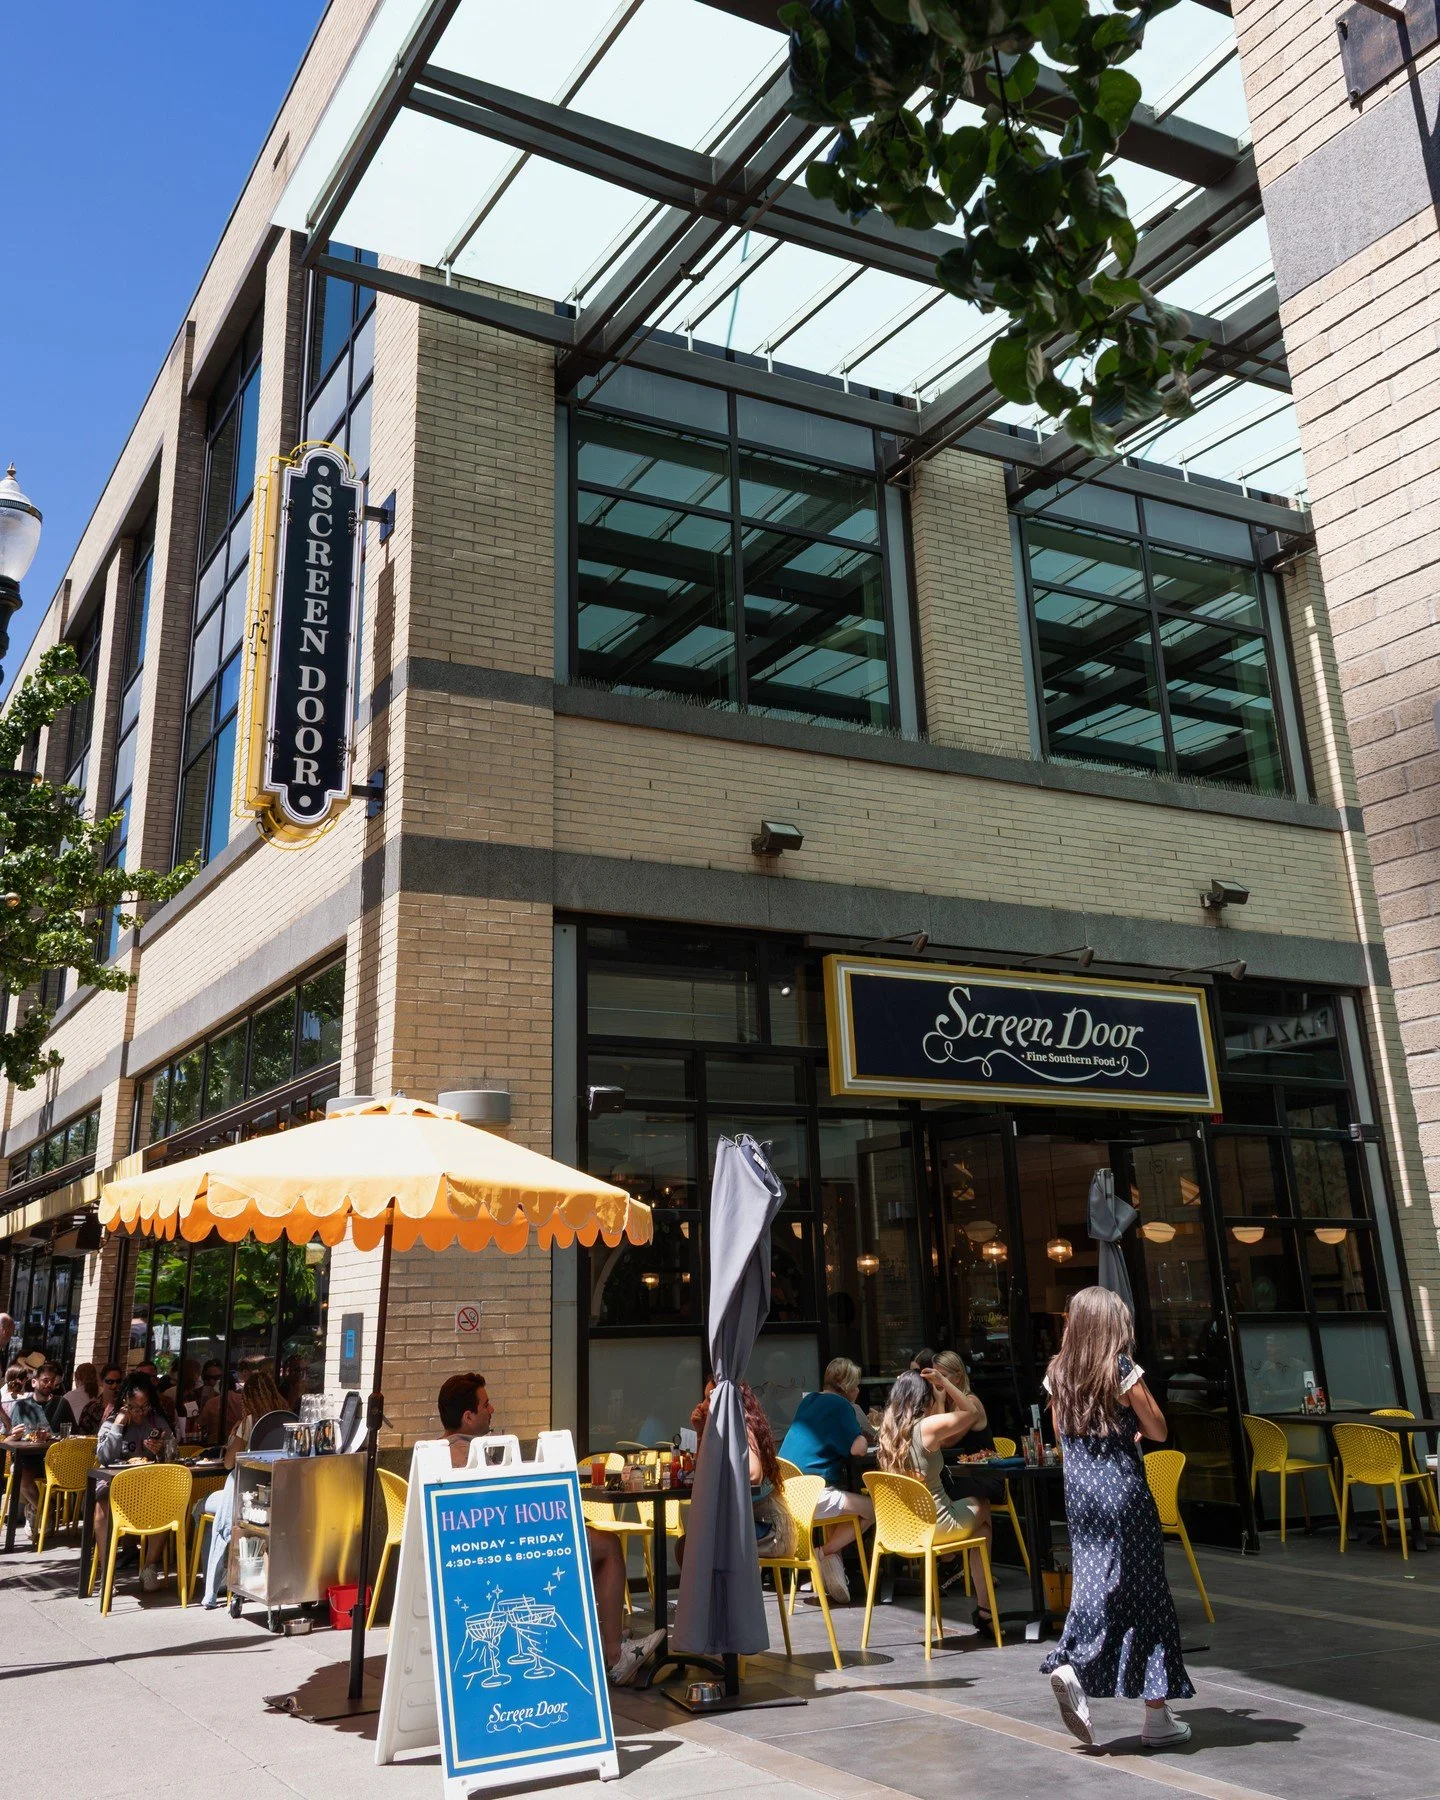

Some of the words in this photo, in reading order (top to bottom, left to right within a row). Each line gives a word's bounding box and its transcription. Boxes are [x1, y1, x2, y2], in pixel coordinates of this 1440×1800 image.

[300, 484, 333, 655] SCREEN
[292, 665, 326, 786] DOOR
[936, 986, 1053, 1048] Screen
[1055, 1006, 1145, 1051] Door
[1025, 1051, 1048, 1062] Fine
[1048, 1053, 1092, 1065] Southern
[1093, 1056, 1116, 1067] Food
[441, 1506, 507, 1531] HAPPY
[514, 1500, 568, 1524] HOUR
[451, 1539, 506, 1553] MONDAY
[519, 1532, 564, 1546] FRIDAY
[446, 1556, 502, 1567] 4:30-5:30
[505, 1553, 513, 1562] &
[515, 1547, 572, 1561] 8:00-9:00
[489, 1703, 534, 1723] Screen
[535, 1700, 568, 1717] Door
